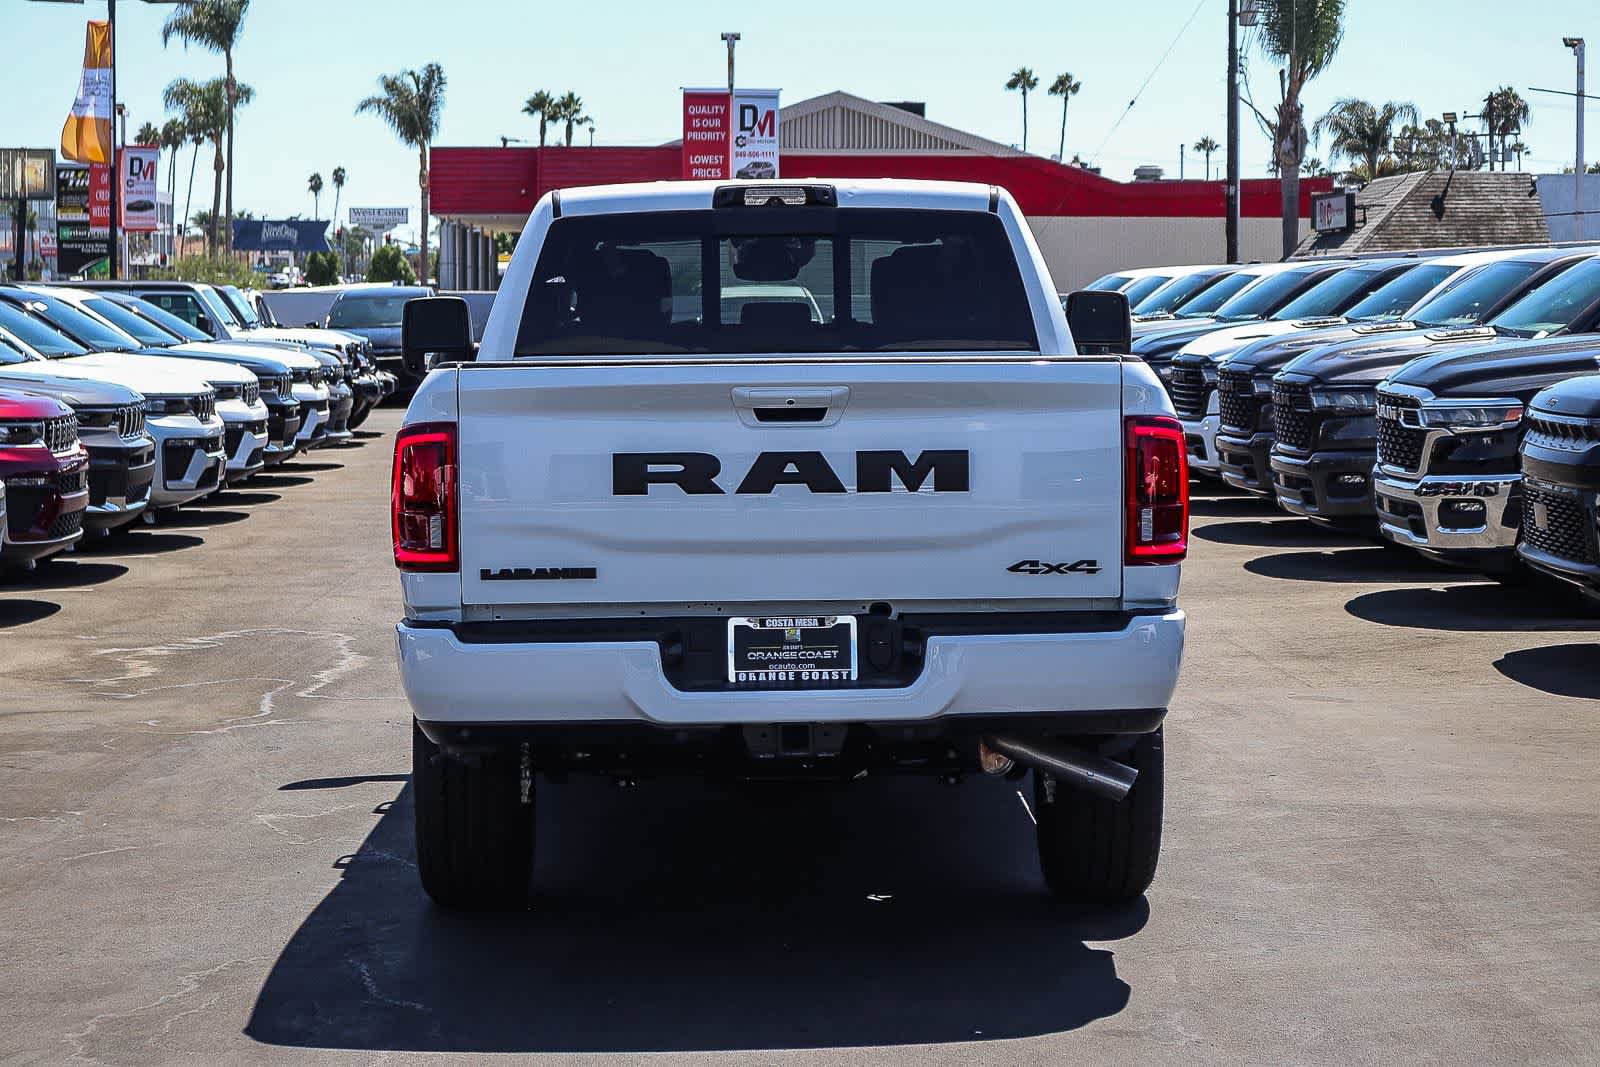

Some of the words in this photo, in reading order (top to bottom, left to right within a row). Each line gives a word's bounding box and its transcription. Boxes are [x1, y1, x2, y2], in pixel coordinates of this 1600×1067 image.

[688, 105, 725, 115] QUALITY
[692, 119, 700, 128] IS
[702, 119, 721, 128] OUR
[687, 132, 726, 141] PRIORITY
[690, 155, 724, 165] LOWEST
[692, 168, 722, 177] PRICES
[612, 450, 969, 496] RAM
[1006, 559, 1104, 575] 4x4
[765, 619, 793, 627] COSTA
[795, 618, 819, 627] MESA
[747, 651, 798, 660] ORANGE
[799, 650, 839, 659] COAST
[768, 662, 816, 670] ocauto.com
[738, 671, 795, 681] ORANGE
[801, 671, 849, 680] COAST
